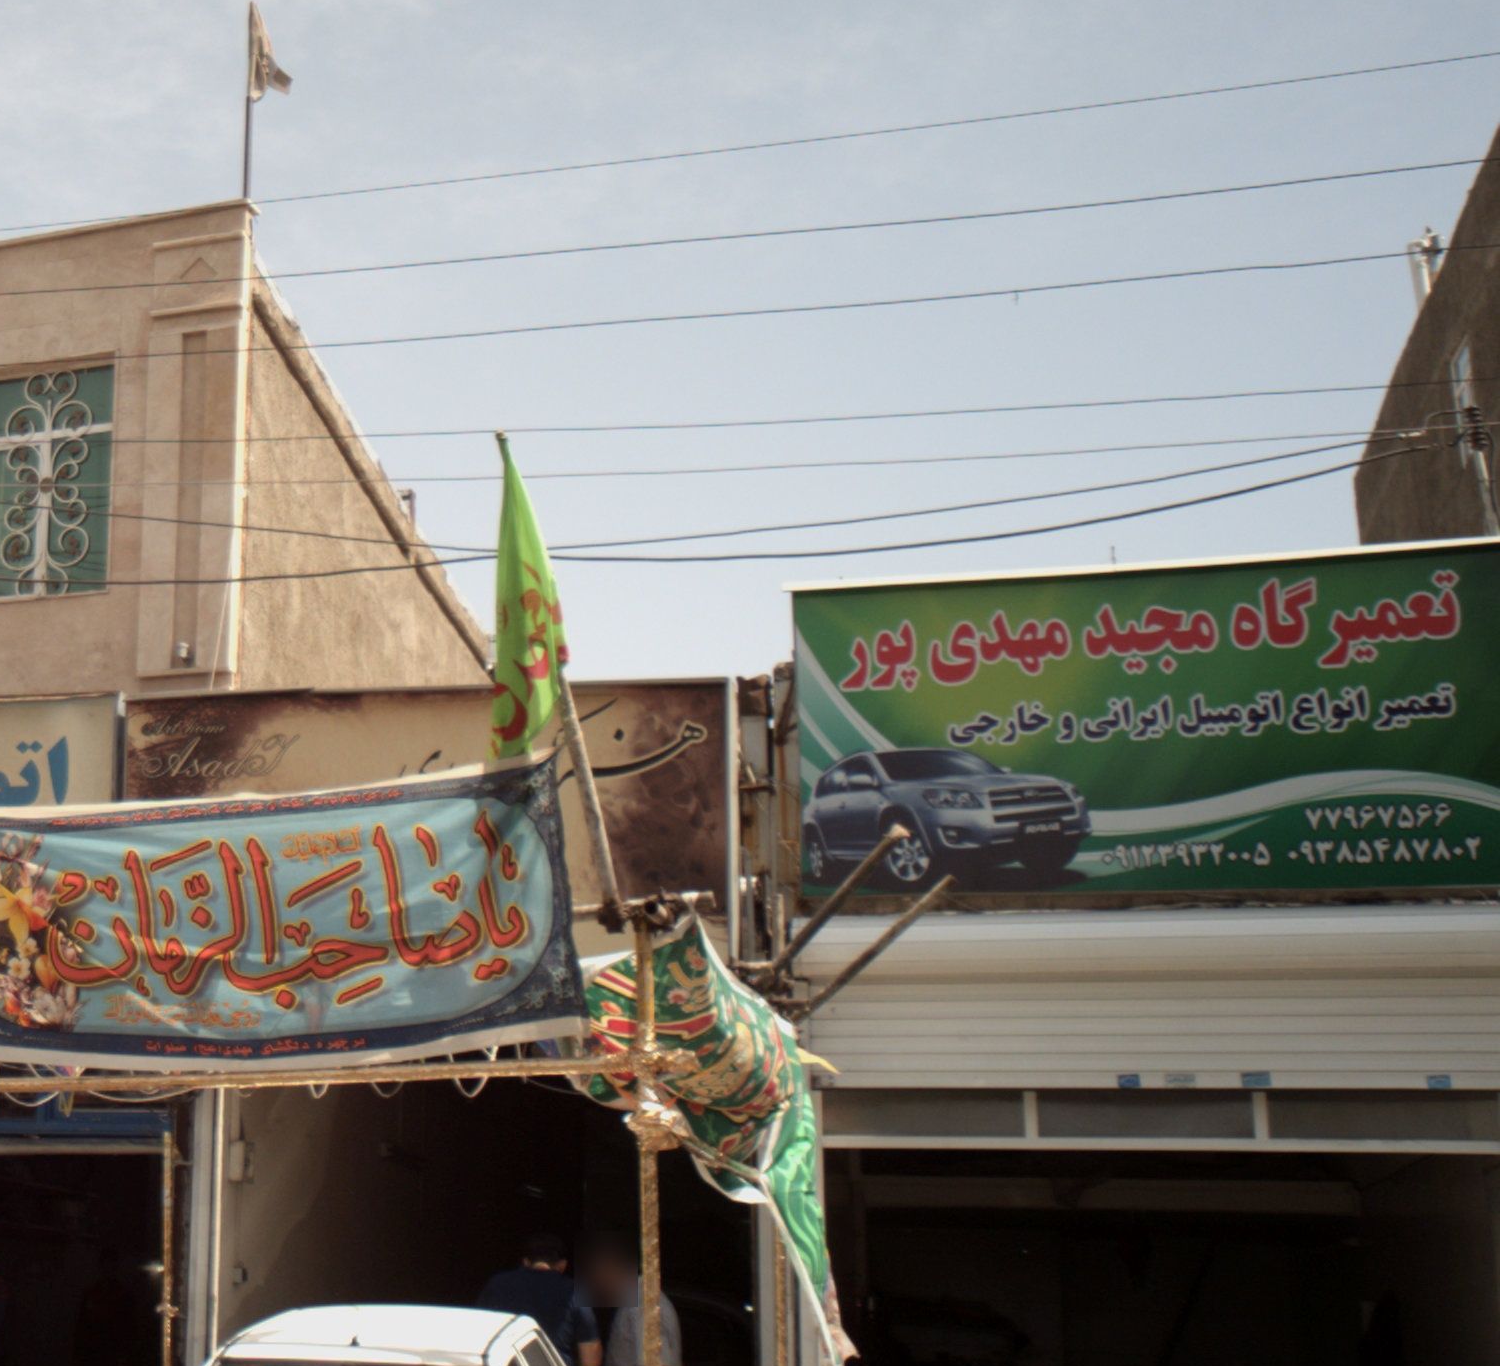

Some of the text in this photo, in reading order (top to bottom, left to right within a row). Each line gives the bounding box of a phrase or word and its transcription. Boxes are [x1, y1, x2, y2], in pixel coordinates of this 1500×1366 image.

[840, 570, 1460, 692] تعمیر گاه مجید مهدی پور
[949, 683, 1456, 745] تعمیر انواع اتومبیل ایرانی و خارجی
[1305, 803, 1451, 830] ۷۷۹۶۷۵۶۶
